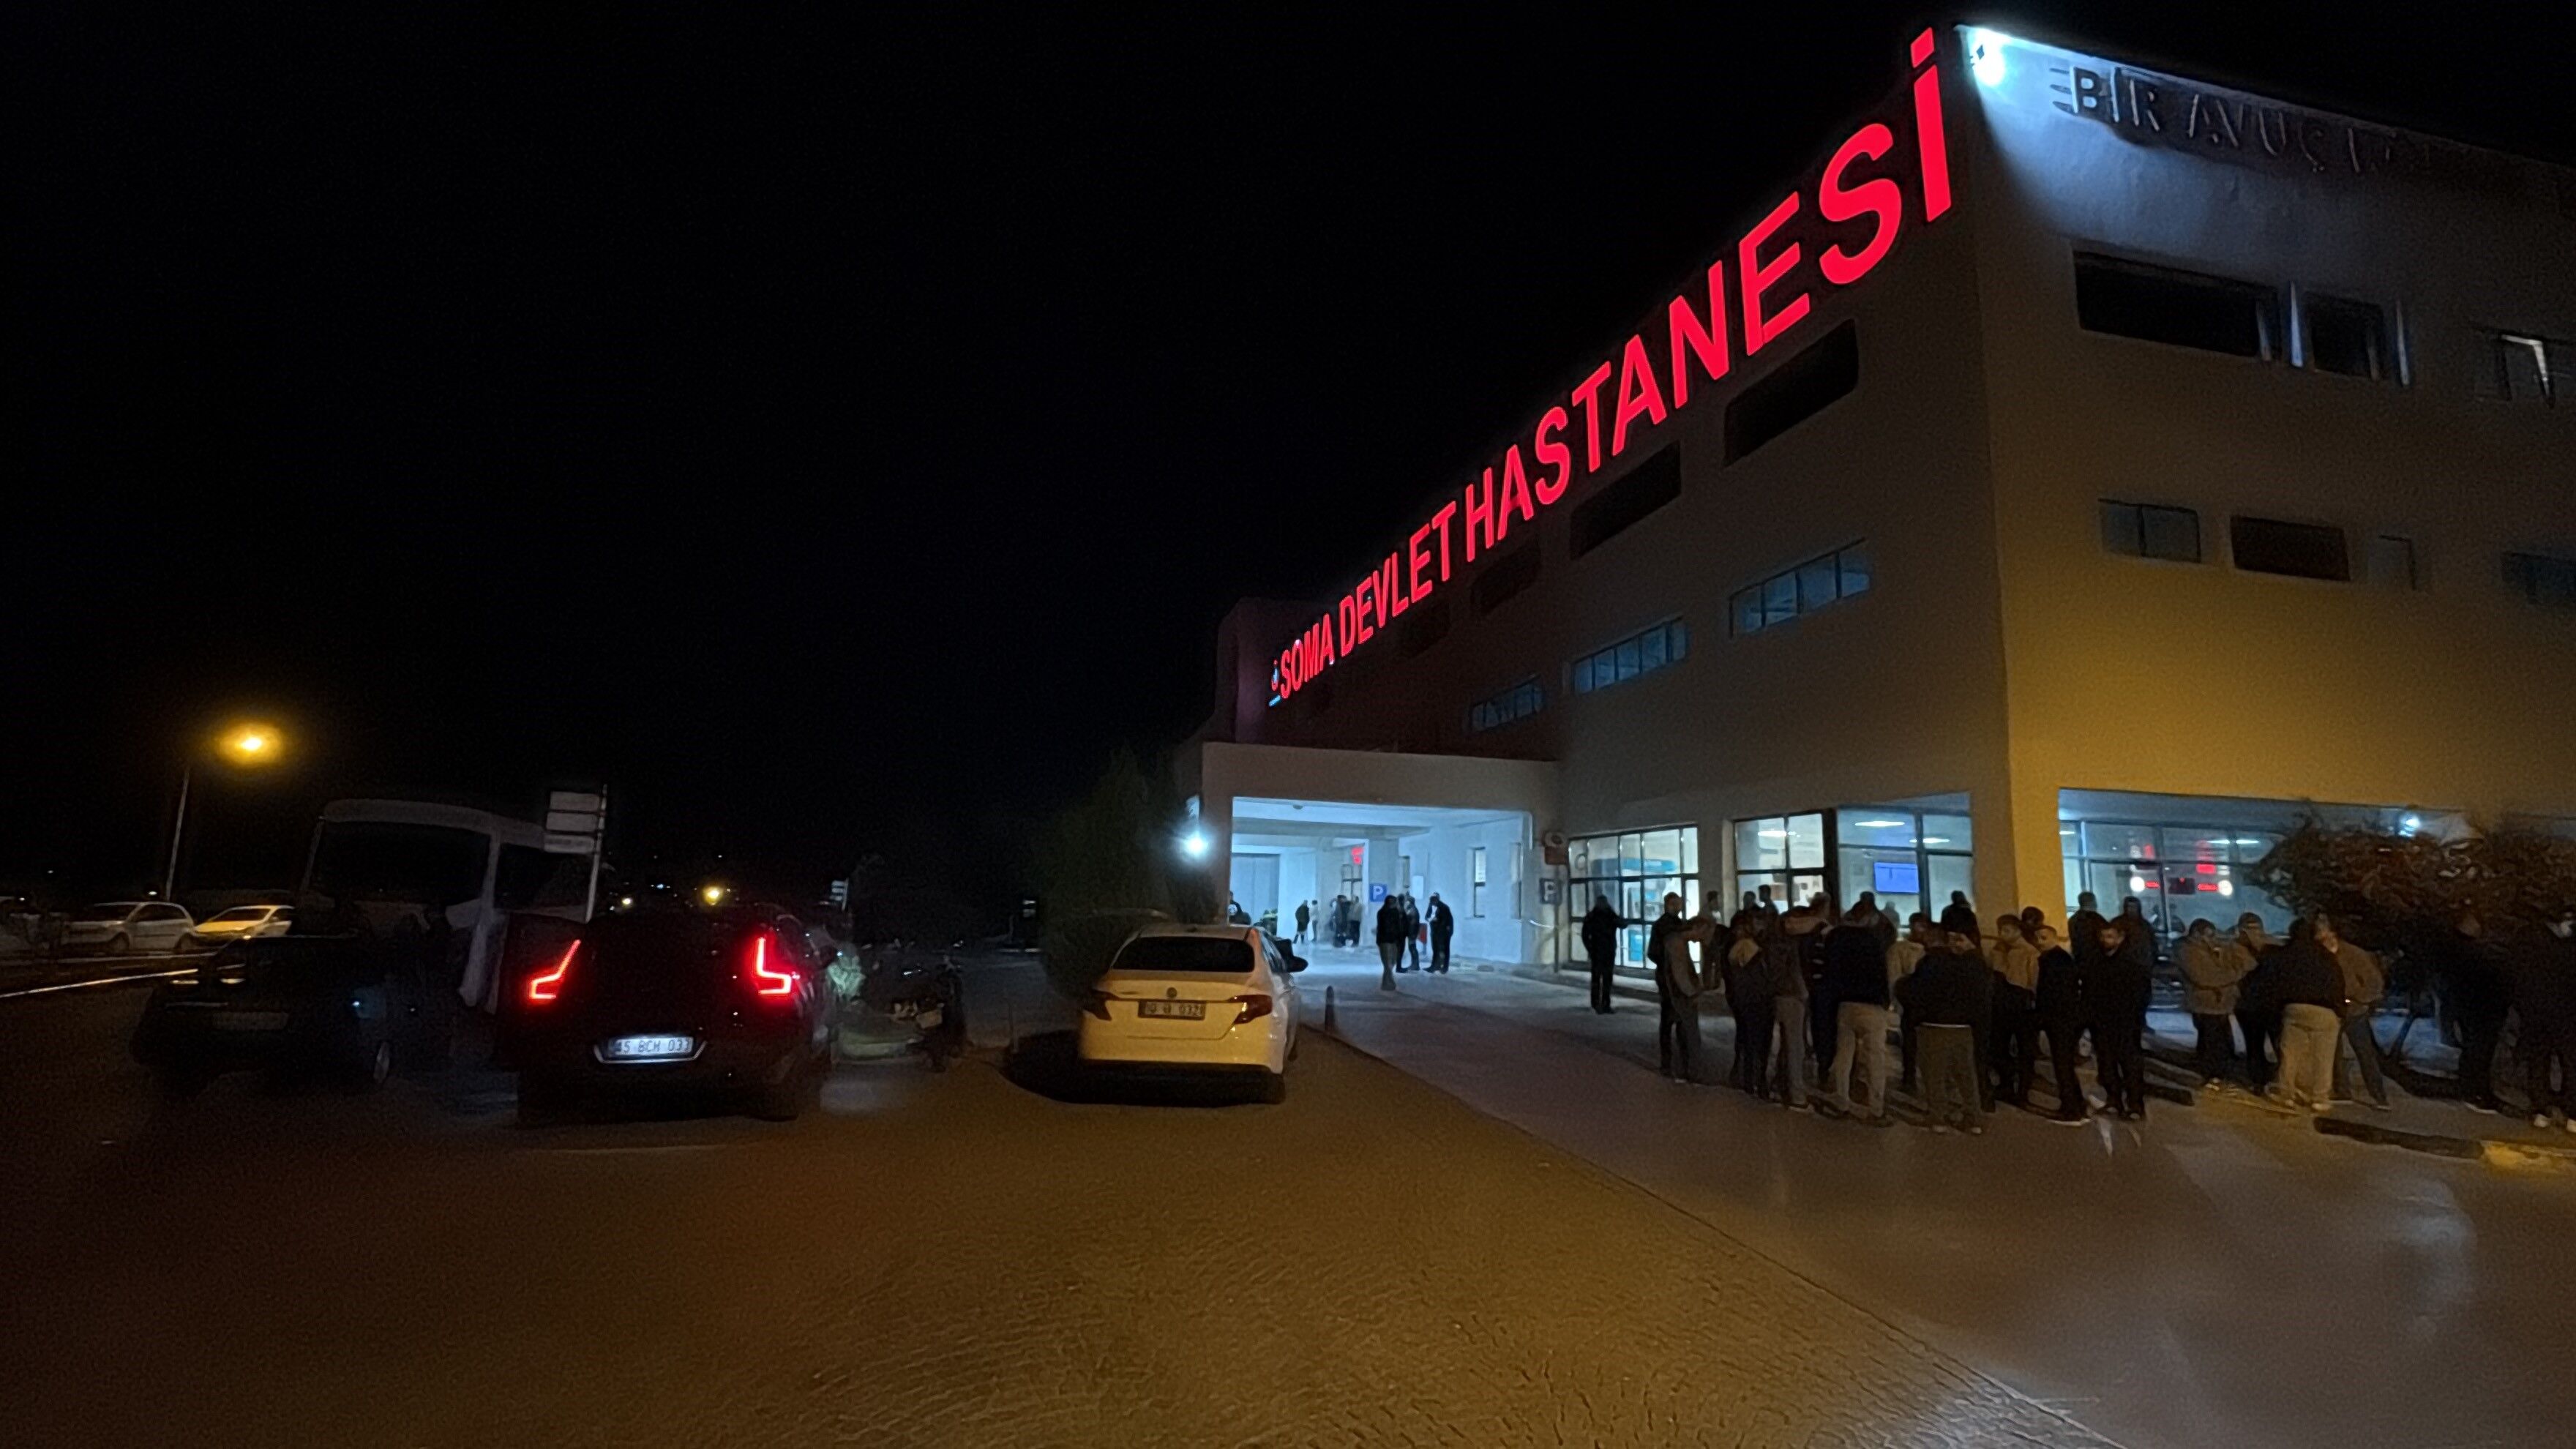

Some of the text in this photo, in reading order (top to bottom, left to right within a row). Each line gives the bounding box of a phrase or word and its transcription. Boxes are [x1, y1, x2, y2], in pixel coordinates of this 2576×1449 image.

[1279, 27, 1952, 700] SOMA DEVLET HASTANESİ
[1373, 885, 1383, 900] P
[1543, 881, 1556, 902] P
